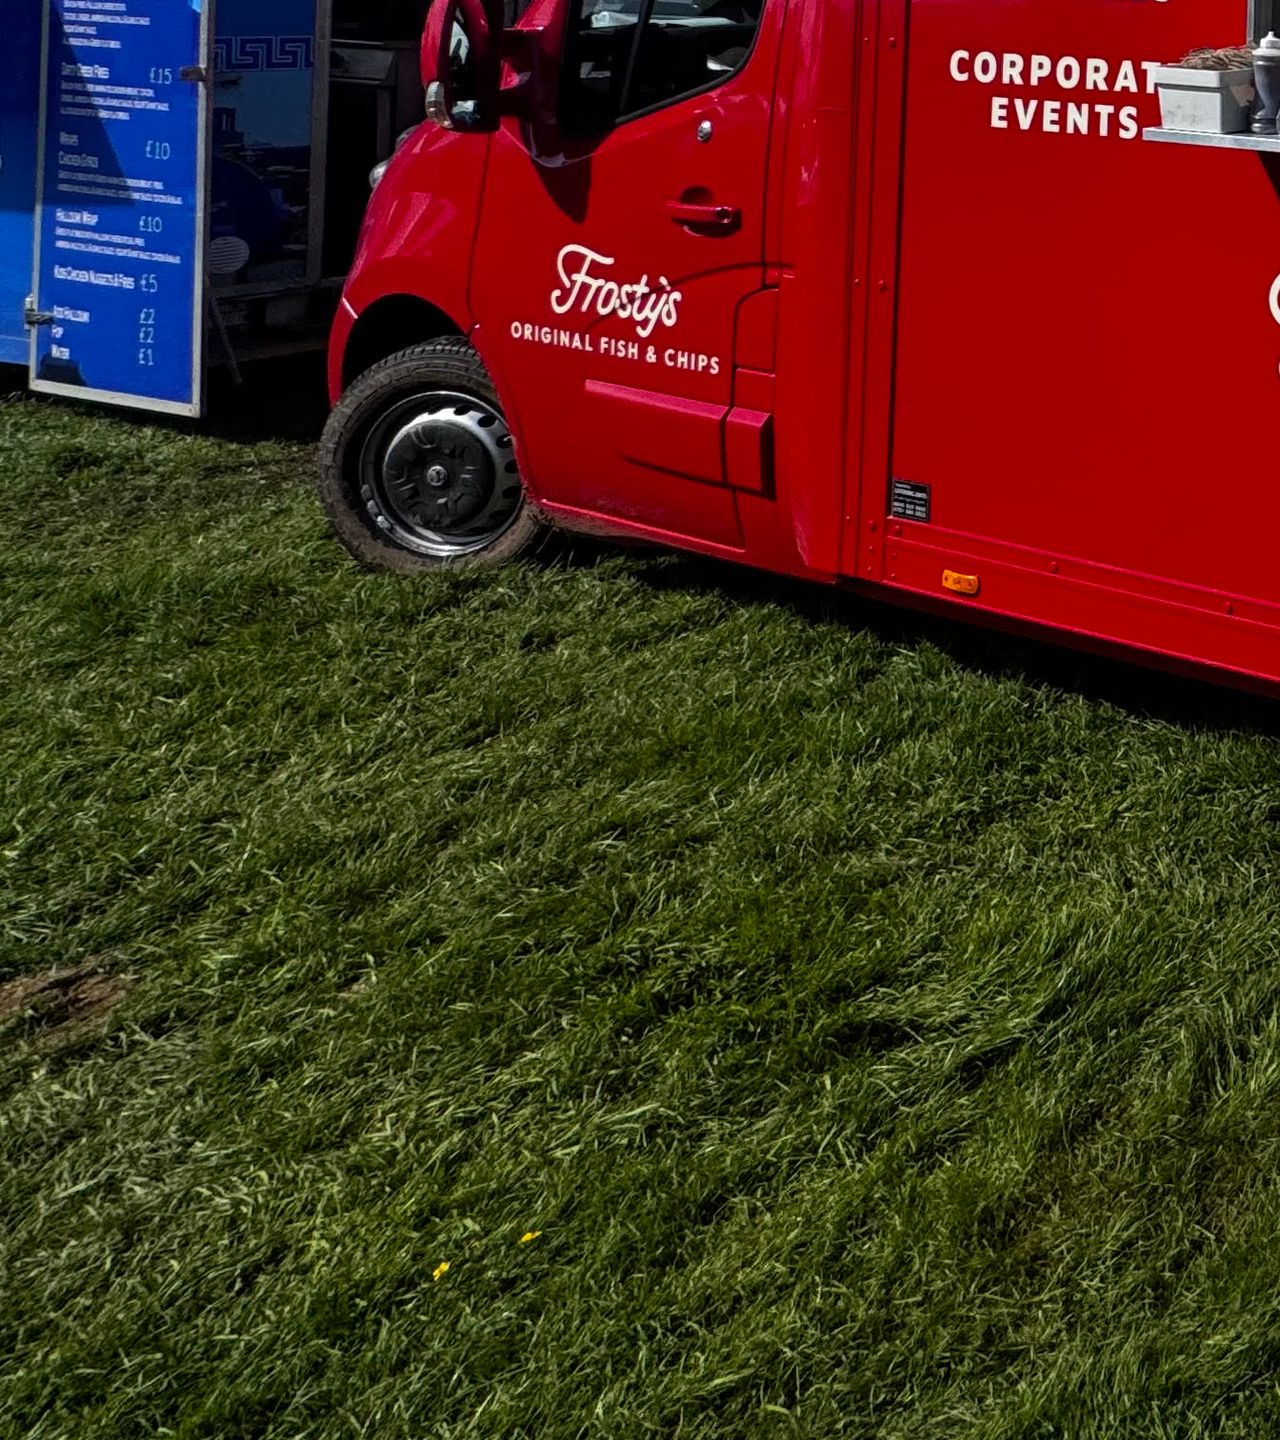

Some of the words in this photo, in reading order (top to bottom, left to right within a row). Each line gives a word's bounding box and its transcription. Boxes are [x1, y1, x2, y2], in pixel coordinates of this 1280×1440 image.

[150, 67, 172, 86] £15
[950, 50, 1161, 94] CORPORAT
[991, 96, 1138, 139] EVENTS
[145, 140, 170, 160] £10
[139, 216, 163, 233] £10
[140, 273, 157, 293] £5
[140, 308, 155, 324] £2
[139, 327, 154, 344] £2
[511, 321, 593, 351] ORIGINAL
[600, 337, 638, 359] FISH
[646, 345, 656, 363] &
[665, 348, 719, 375] CHIPS
